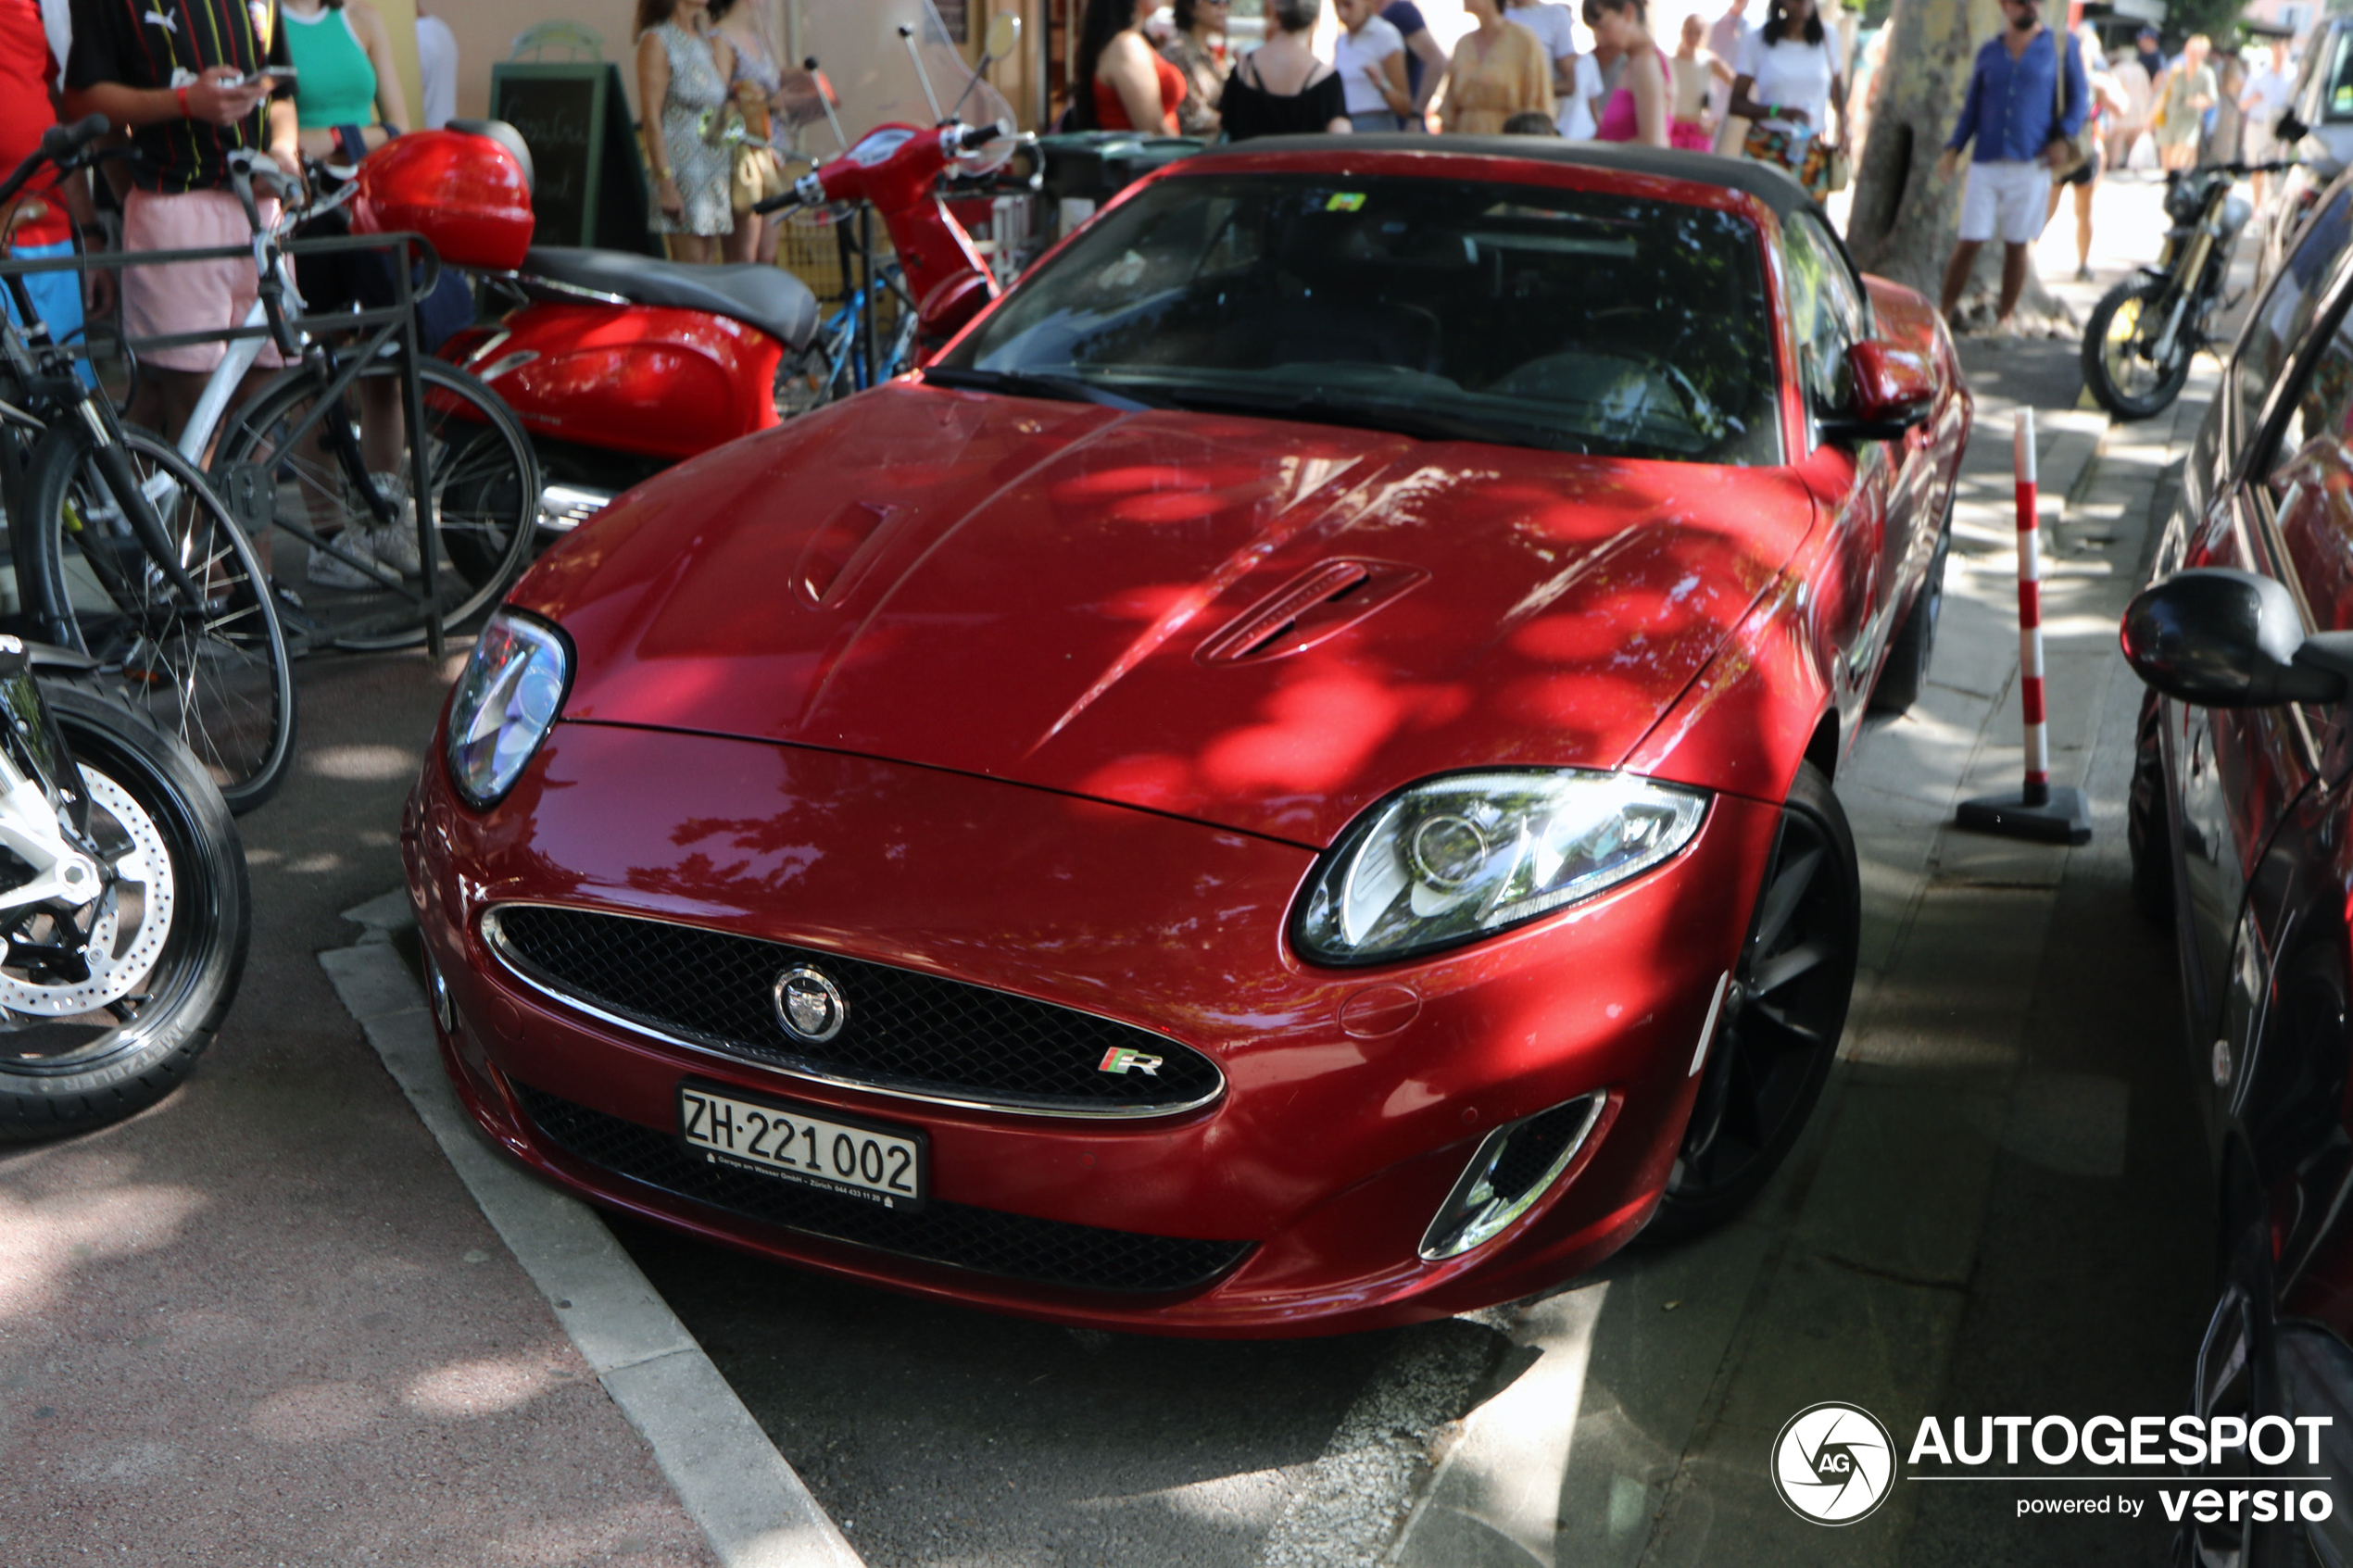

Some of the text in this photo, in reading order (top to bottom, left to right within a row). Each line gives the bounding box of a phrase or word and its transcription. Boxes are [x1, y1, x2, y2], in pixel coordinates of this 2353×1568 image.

[63, 1029, 184, 1091] METZELER
[718, 1156, 742, 1169] Garage
[755, 1165, 779, 1178] Wasser
[781, 1172, 802, 1184] GmbH
[810, 1179, 833, 1191] Zürich
[835, 1185, 847, 1195] 044
[849, 1187, 862, 1198] 433
[863, 1191, 871, 1199] 11
